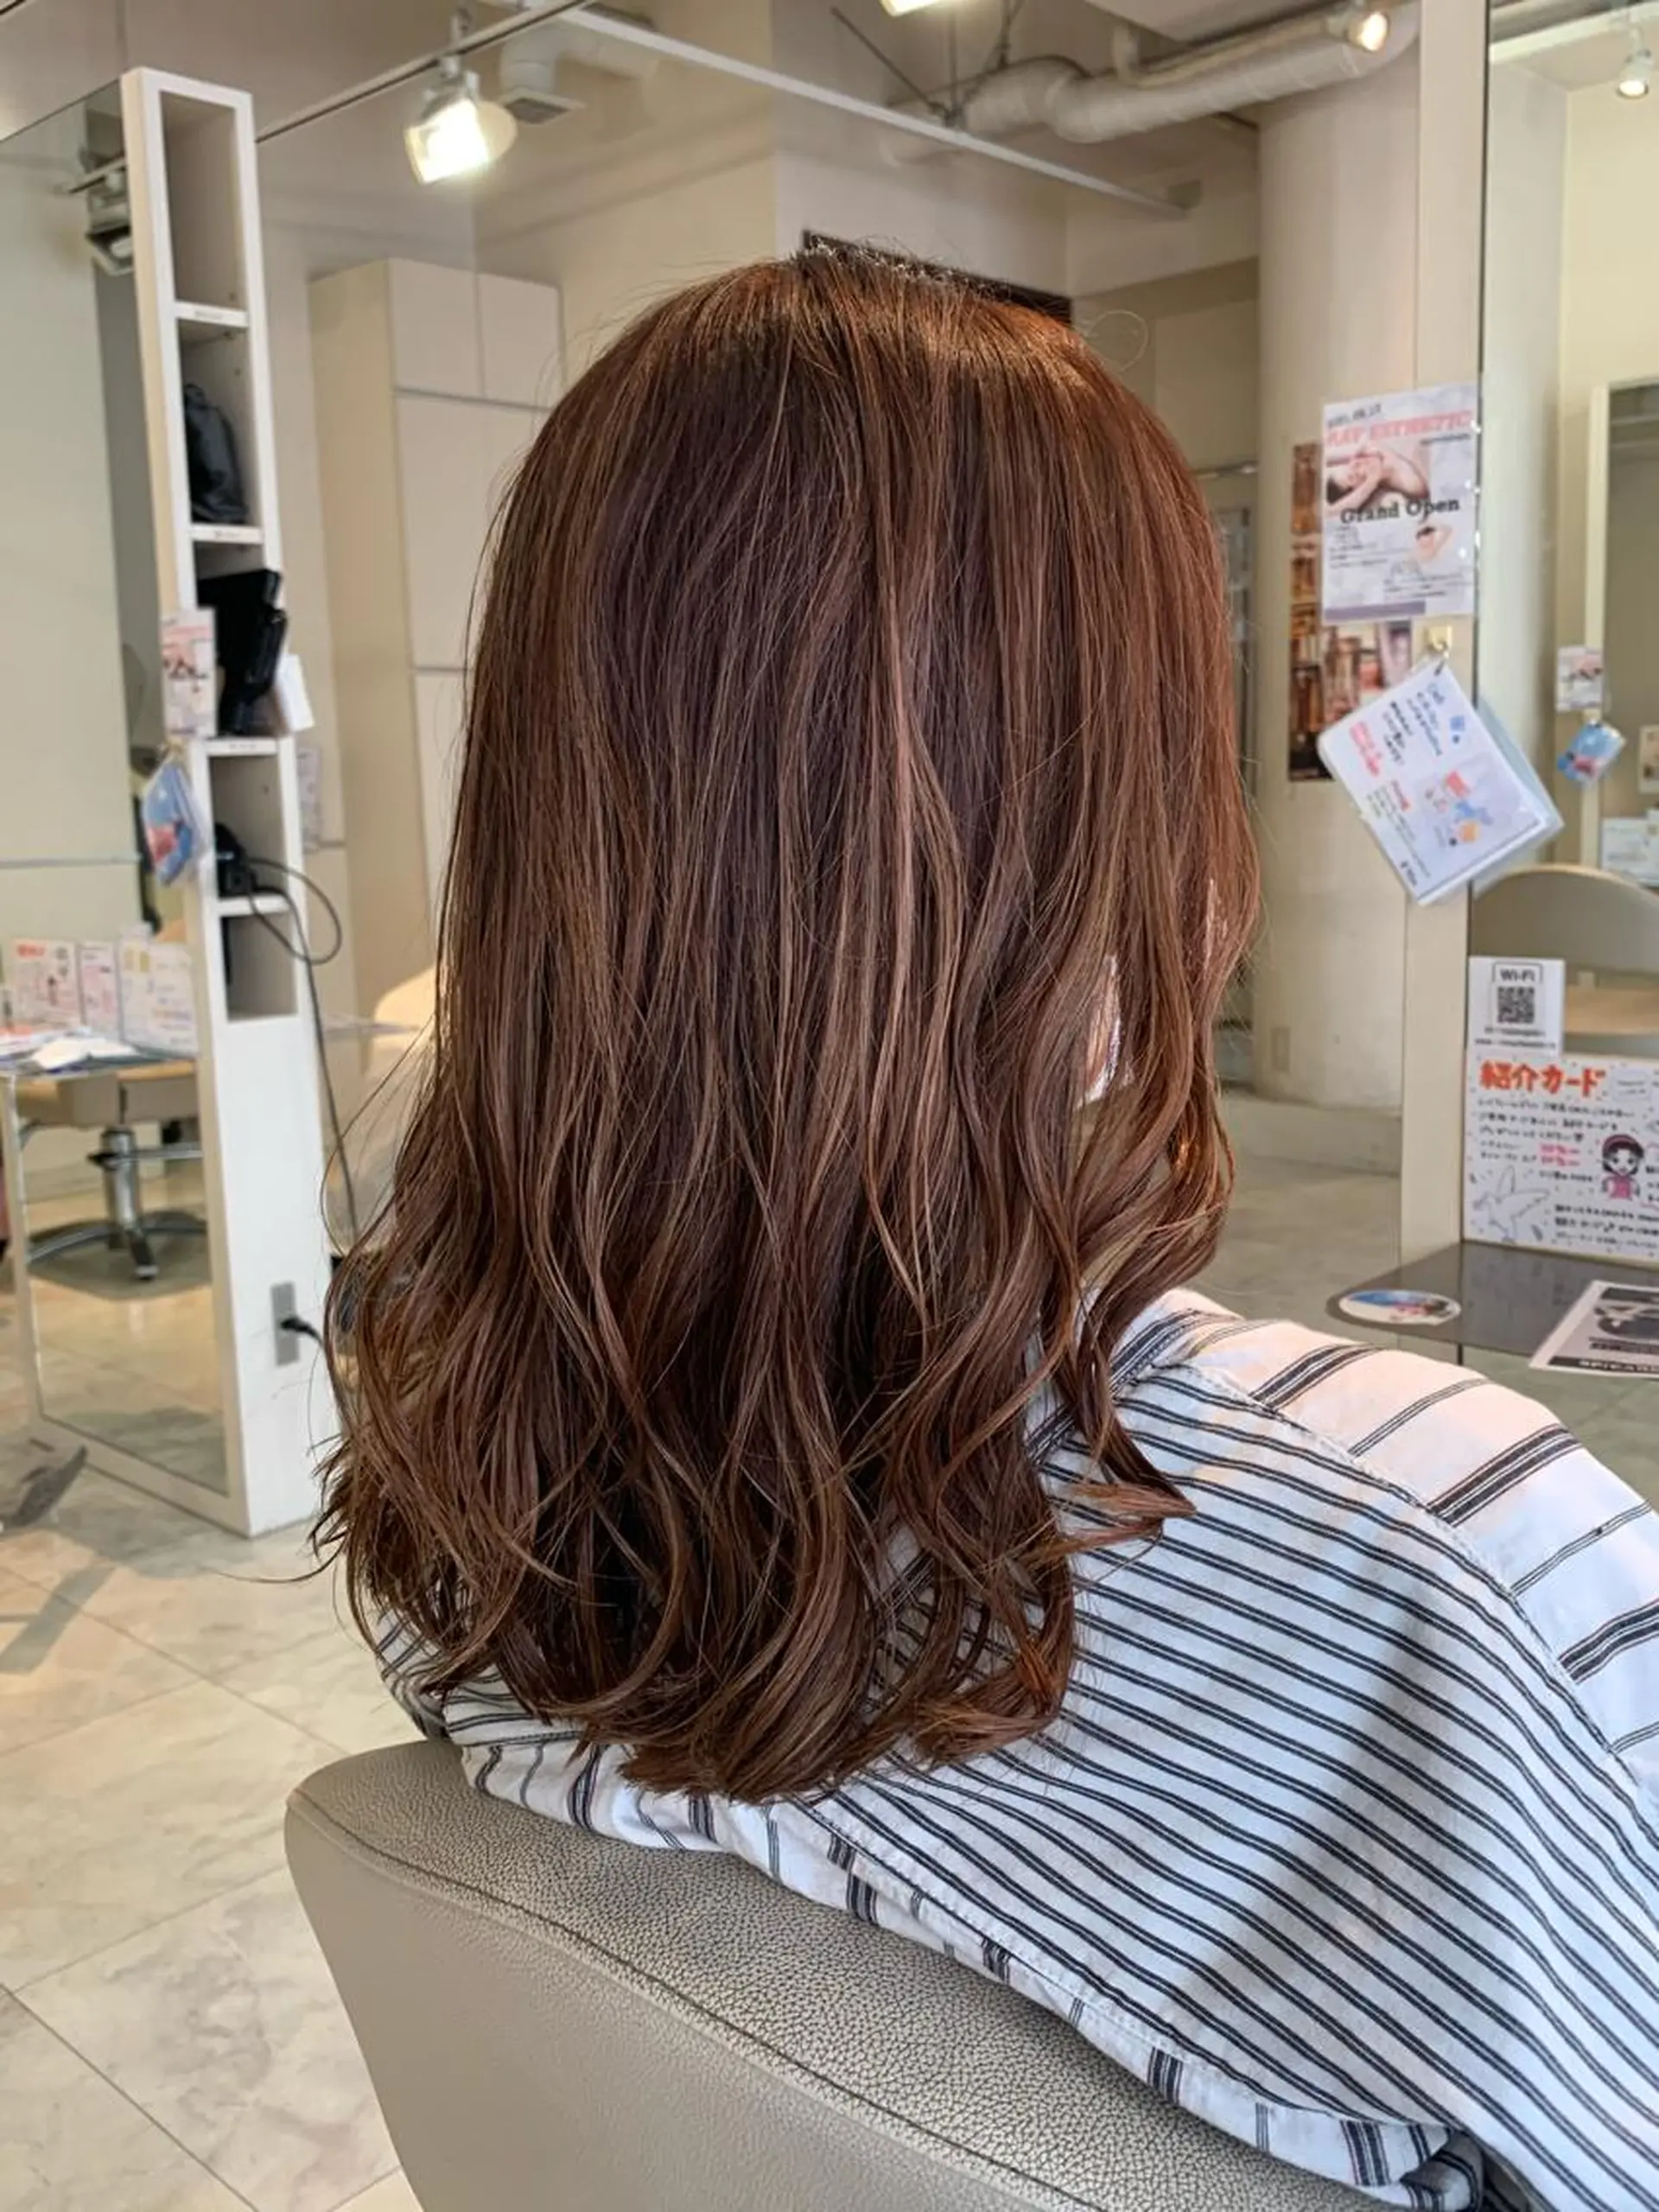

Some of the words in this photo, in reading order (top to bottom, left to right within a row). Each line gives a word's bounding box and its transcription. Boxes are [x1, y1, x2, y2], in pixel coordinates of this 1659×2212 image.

[1341, 502, 1400, 524] Grand
[1407, 498, 1459, 522] Open
[1481, 1060, 1605, 1097] 紹介カード
